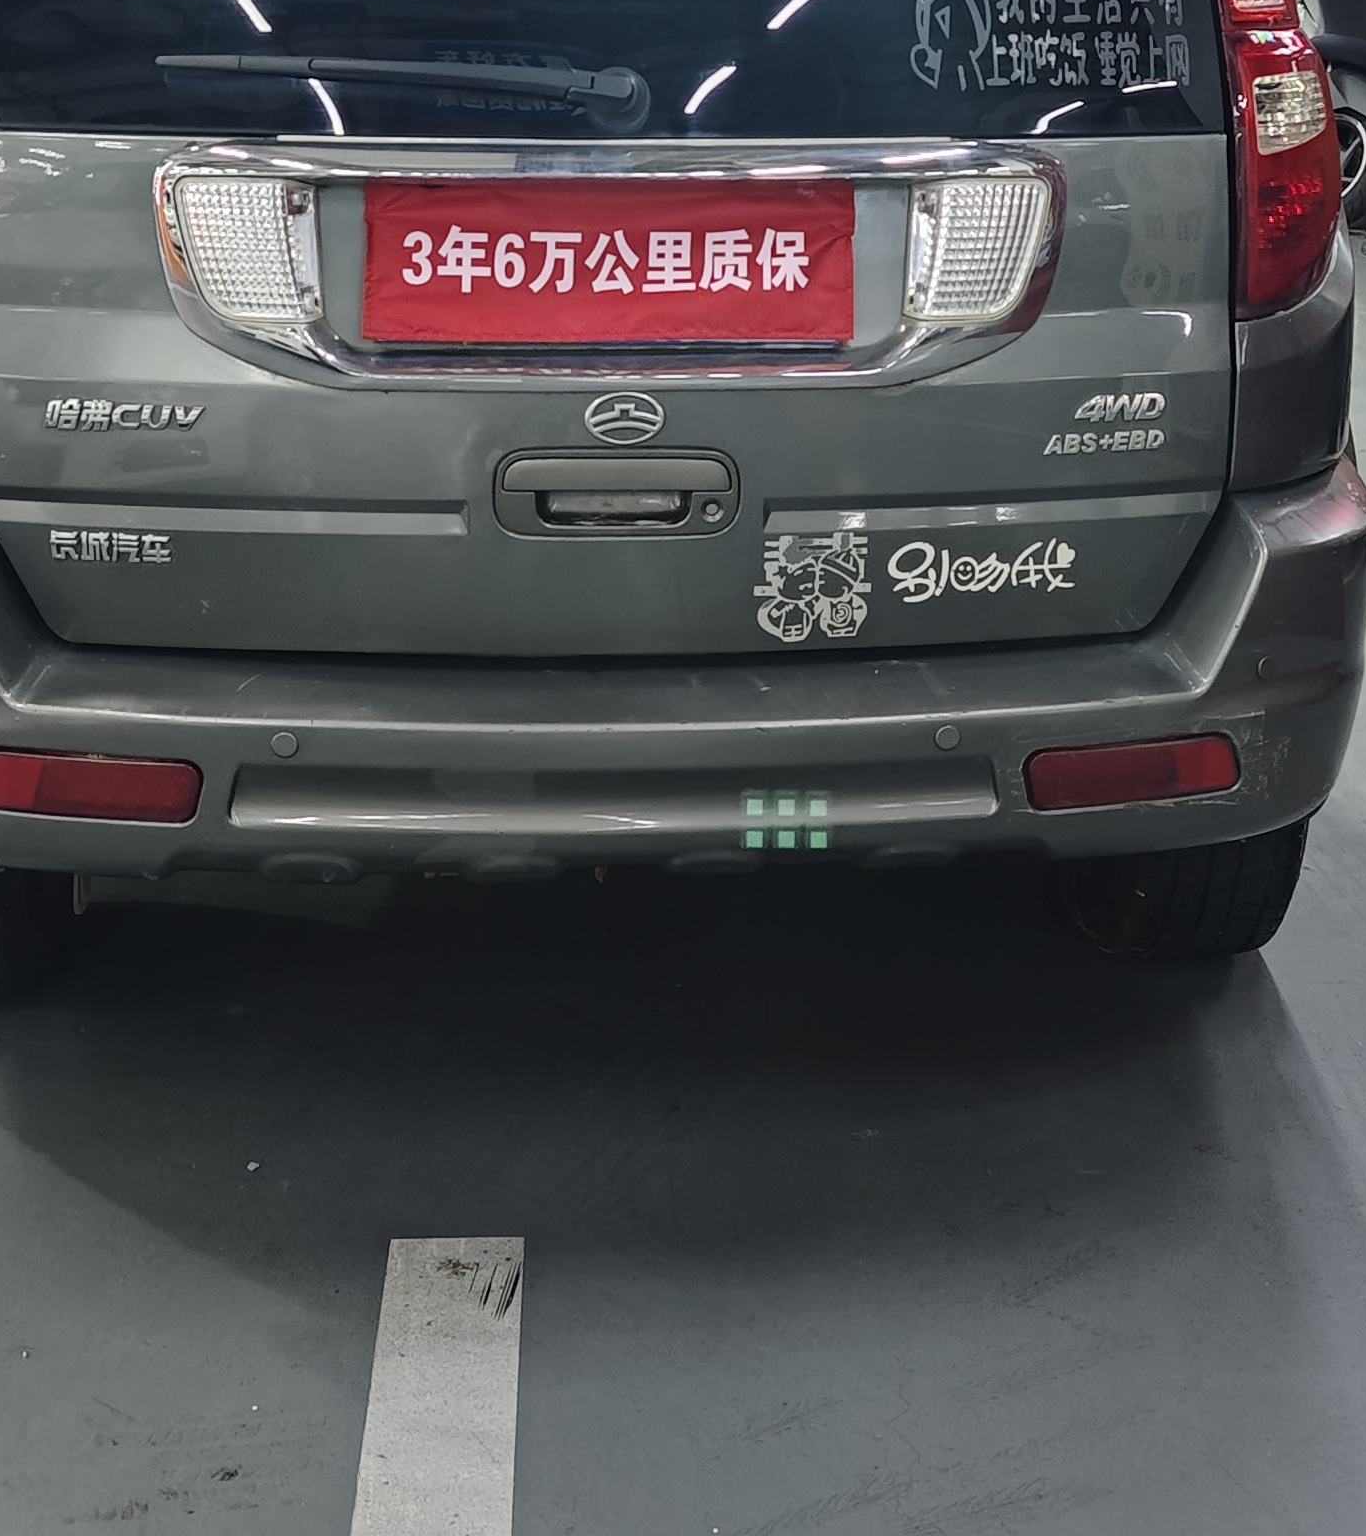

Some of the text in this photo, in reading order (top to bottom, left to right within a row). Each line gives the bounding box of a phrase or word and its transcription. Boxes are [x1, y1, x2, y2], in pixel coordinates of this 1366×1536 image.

[401, 224, 811, 296] 3年6万公里质保
[1073, 392, 1167, 423] 4WD
[1042, 429, 1166, 456] ABS+EBD
[49, 529, 173, 564] 长城汽车
